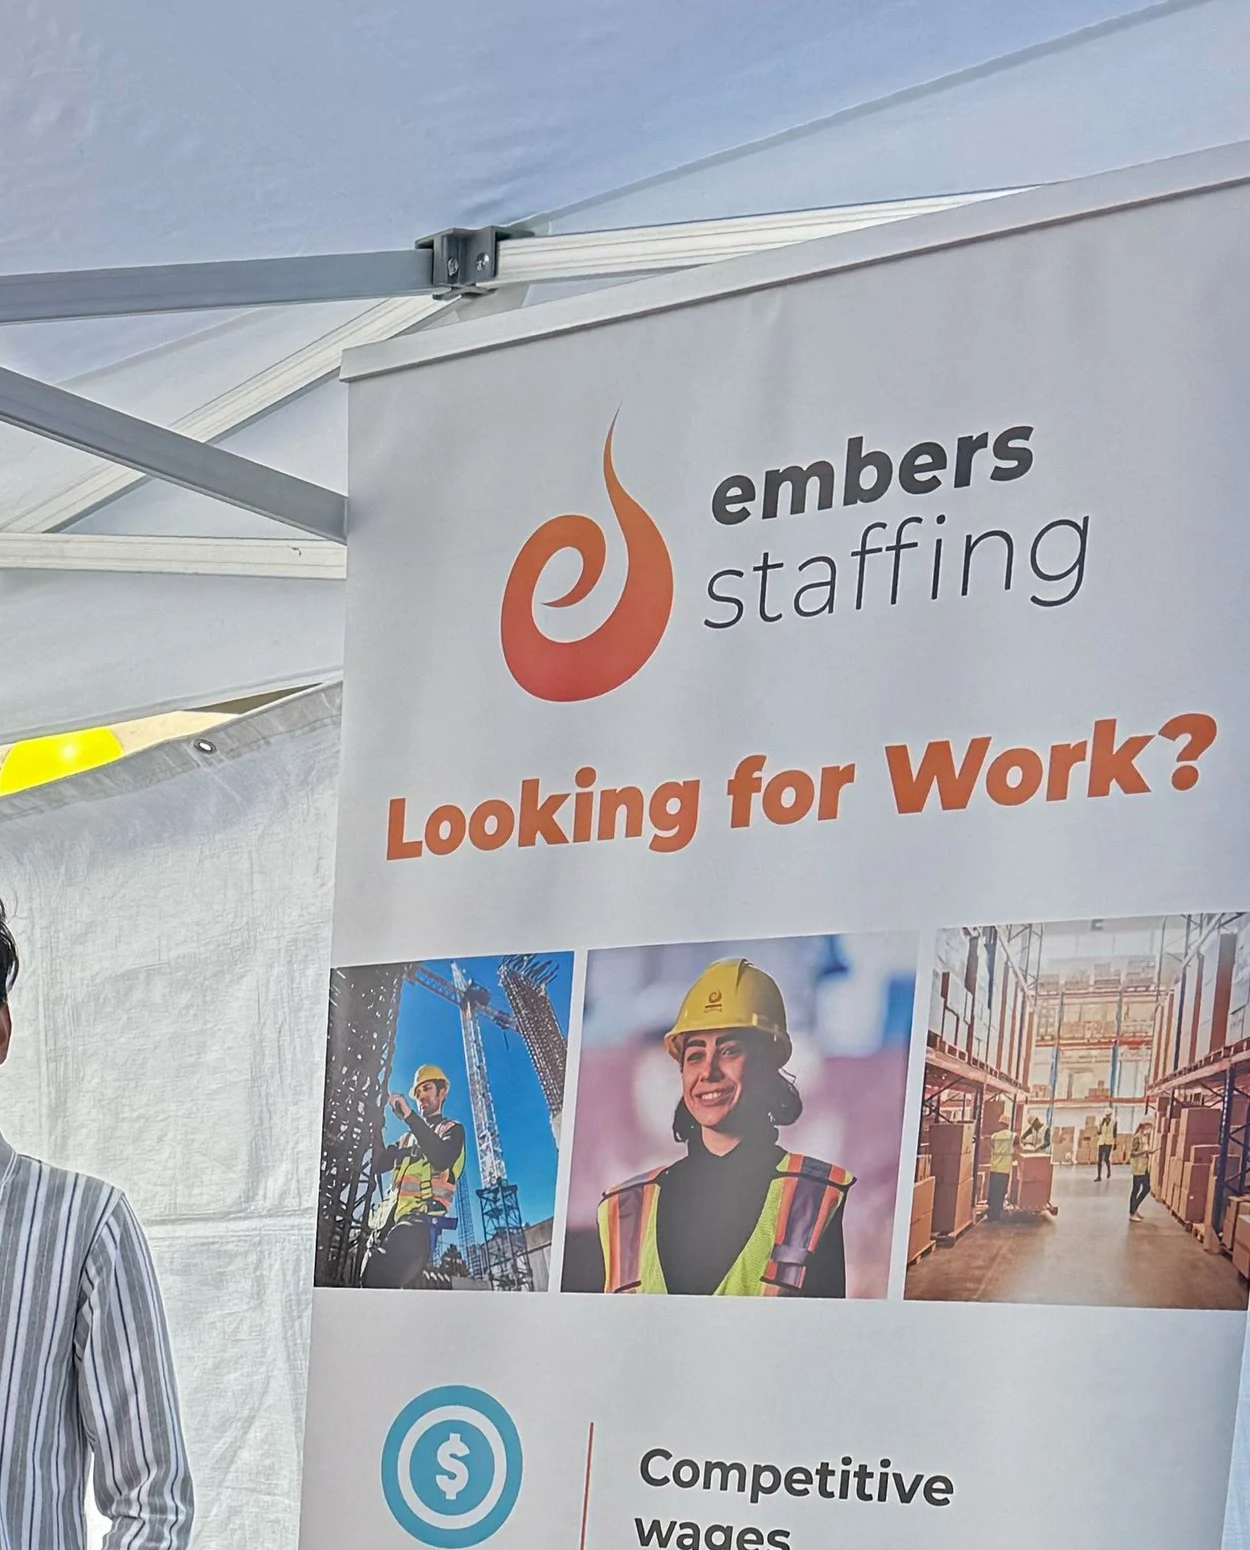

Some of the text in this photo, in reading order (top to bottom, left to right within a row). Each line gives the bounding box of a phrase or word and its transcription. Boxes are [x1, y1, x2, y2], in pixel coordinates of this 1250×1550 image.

[712, 426, 1033, 525] embers
[704, 516, 1089, 628] staffing
[388, 715, 1216, 859] Looking for Work?
[641, 1449, 953, 1506] Competitive
